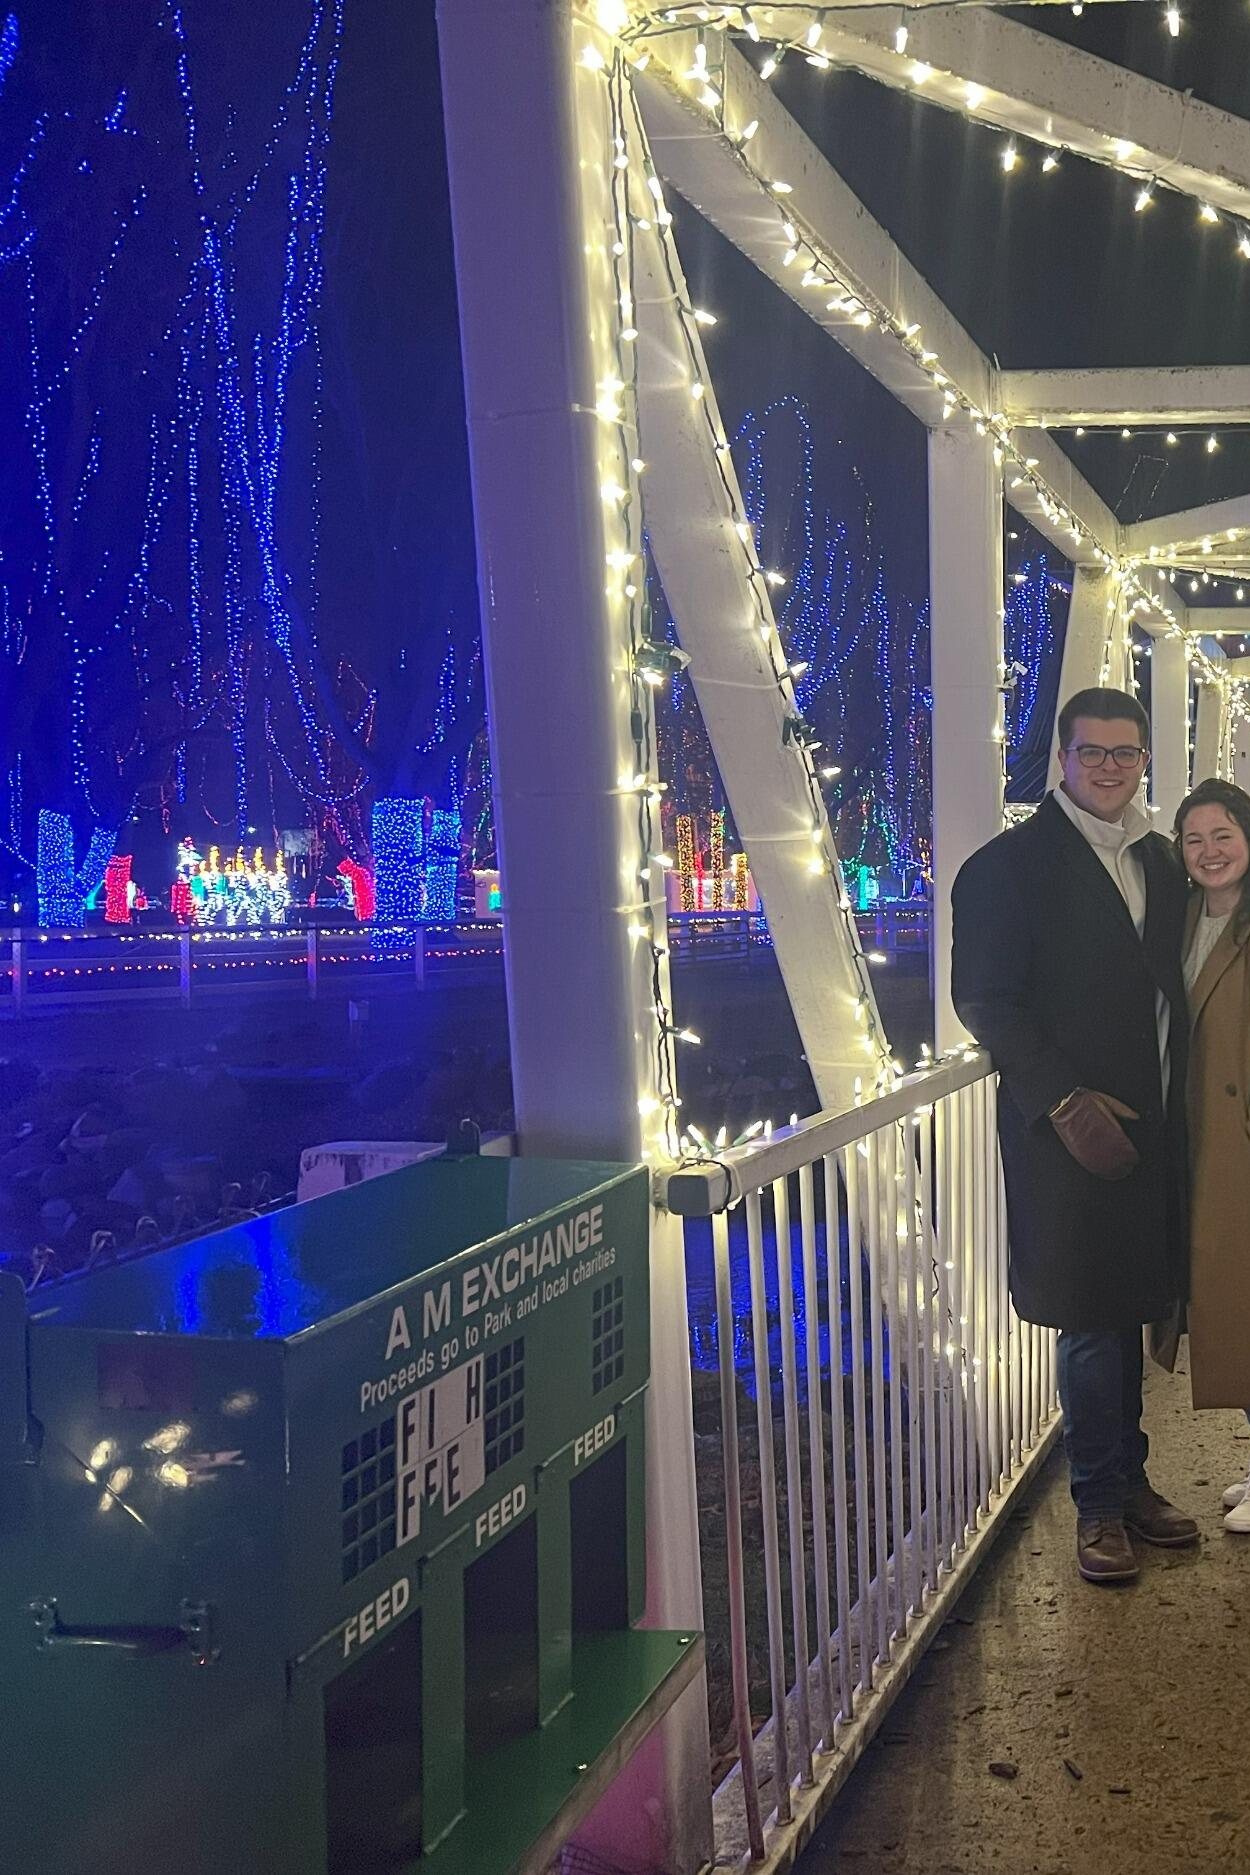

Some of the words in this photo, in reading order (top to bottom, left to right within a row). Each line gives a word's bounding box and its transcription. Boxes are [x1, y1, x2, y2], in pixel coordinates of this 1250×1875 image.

[385, 1306, 411, 1360] A
[423, 1281, 451, 1339] M
[462, 1204, 603, 1317] EXCHANGE
[361, 1350, 435, 1413] Proceeds
[441, 1343, 459, 1369] go
[465, 1322, 479, 1350] to
[484, 1303, 512, 1338] Park
[517, 1284, 539, 1319] and
[542, 1268, 569, 1304] local
[573, 1247, 616, 1286] charities
[573, 1414, 615, 1466] FEED
[476, 1484, 527, 1547] FEED
[343, 1577, 409, 1658] FEED
